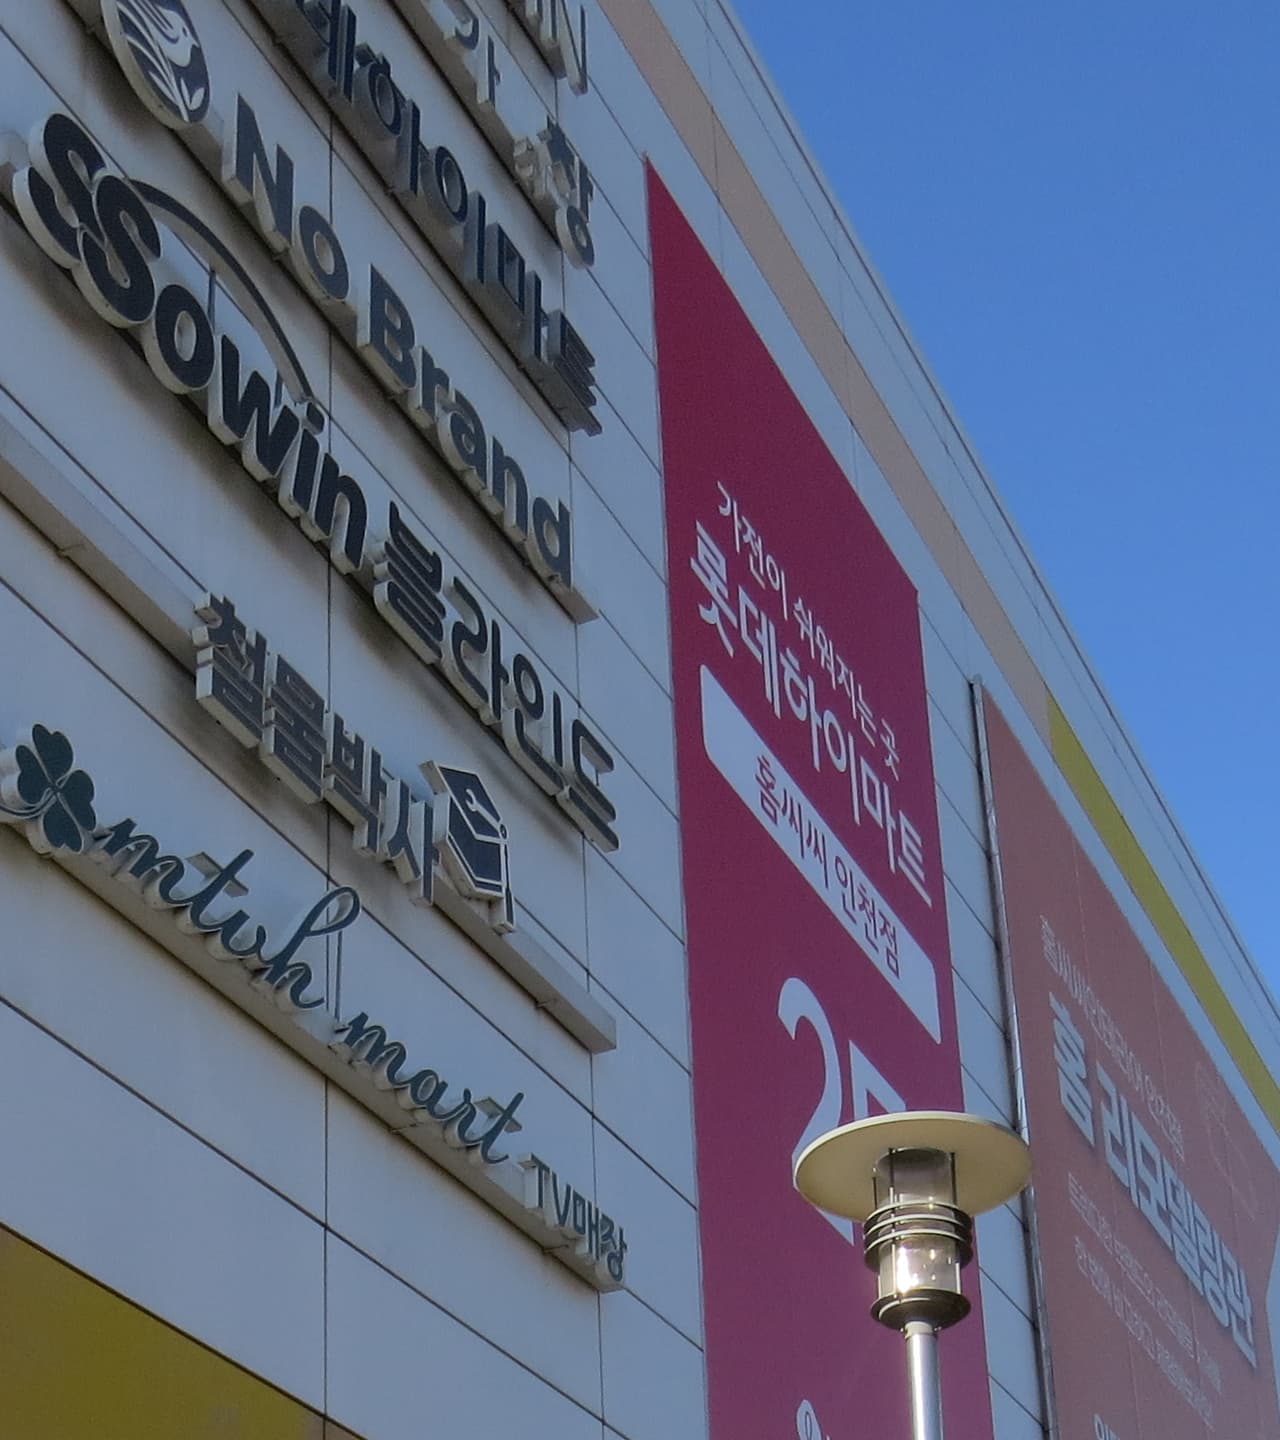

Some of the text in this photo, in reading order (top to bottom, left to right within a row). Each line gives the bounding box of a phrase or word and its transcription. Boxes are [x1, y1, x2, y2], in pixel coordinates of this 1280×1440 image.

[233, 92, 350, 301] No
[365, 264, 572, 590] Brand
[197, 595, 441, 903] 철물박사
[375, 502, 619, 852] 블라인드
[690, 520, 932, 908] 롯데하이마트
[717, 481, 901, 782] 가전이 쉬워지는 곳
[754, 753, 901, 980] 홈씨씨 인천점
[336, 1011, 524, 1165] mart
[1049, 991, 1096, 1149] 홈
[1096, 1060, 1257, 1370] 리모델링관
